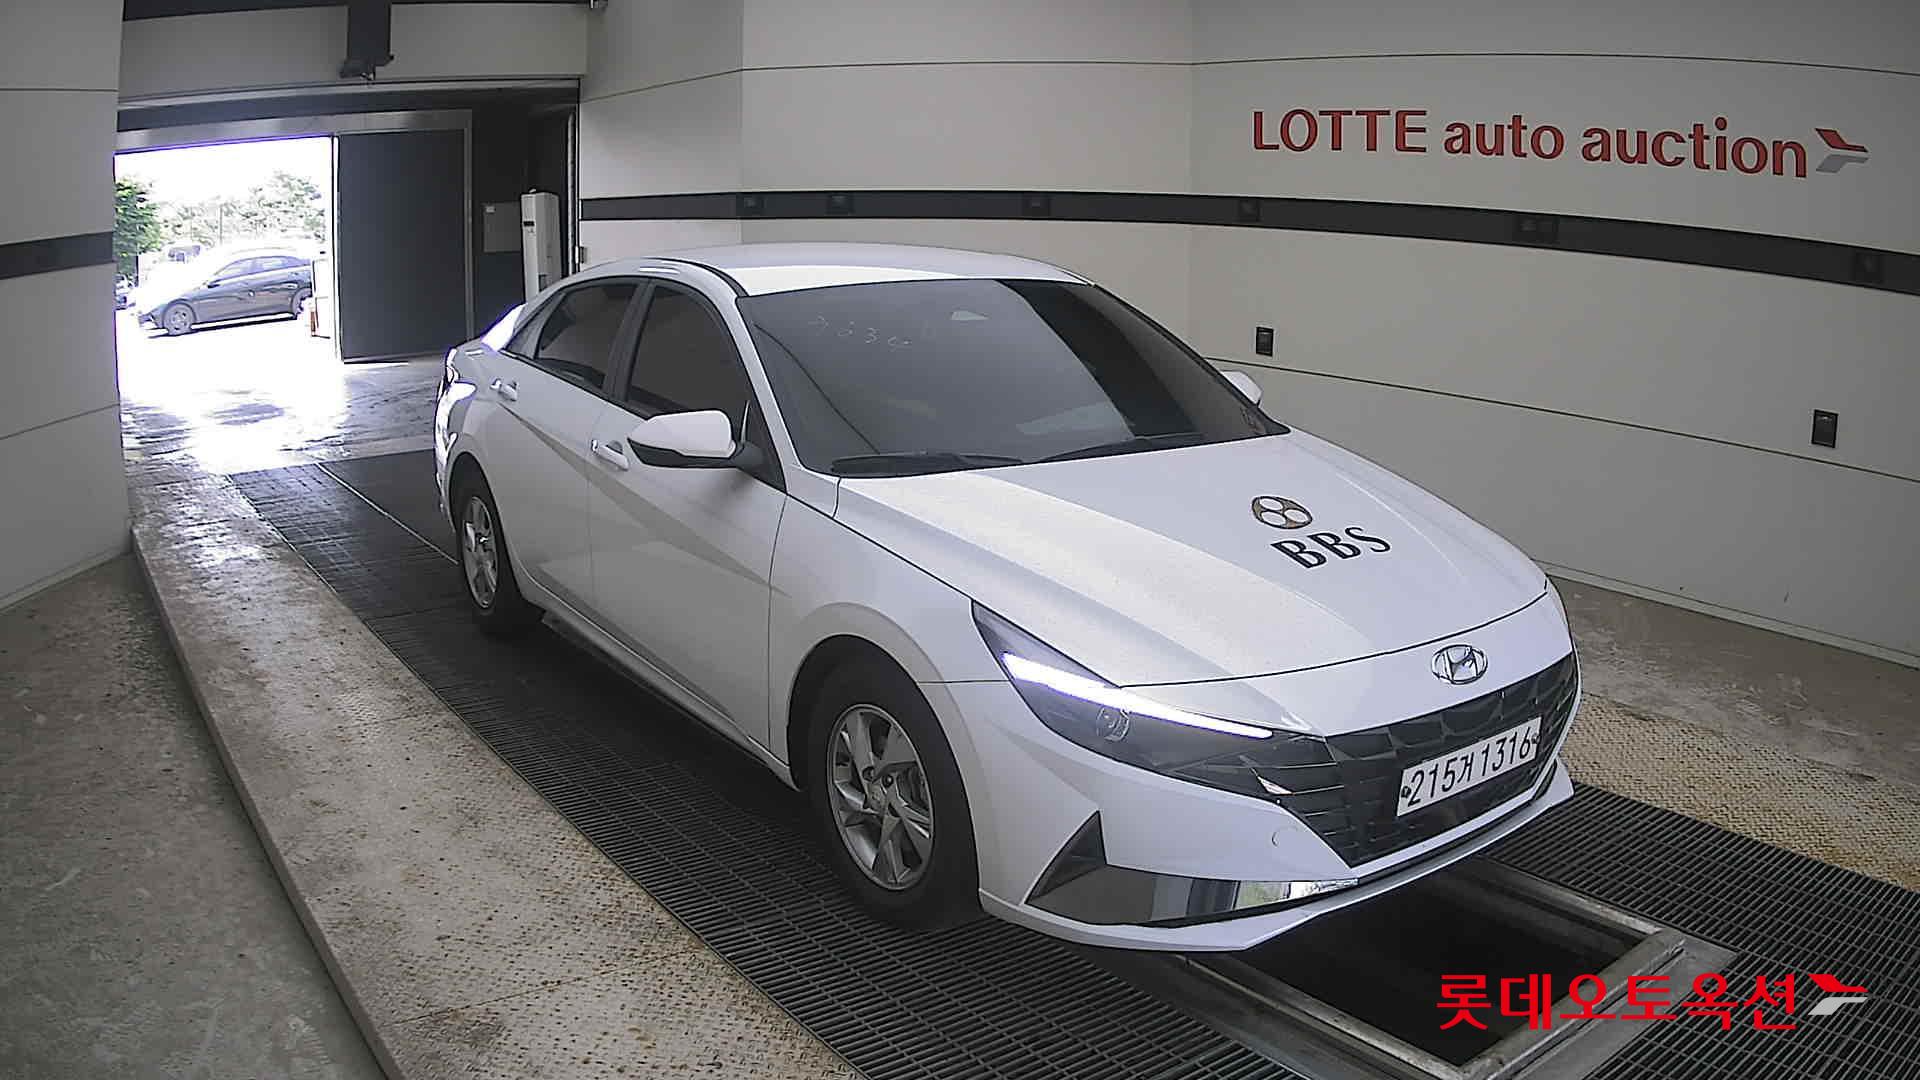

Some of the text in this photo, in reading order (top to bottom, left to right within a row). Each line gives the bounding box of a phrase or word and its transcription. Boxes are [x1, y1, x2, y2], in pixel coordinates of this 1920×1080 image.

[1254, 110, 1807, 178] LOTTE auto auction
[1270, 527, 1391, 568] BBS
[1481, 726, 1531, 777] 1316
